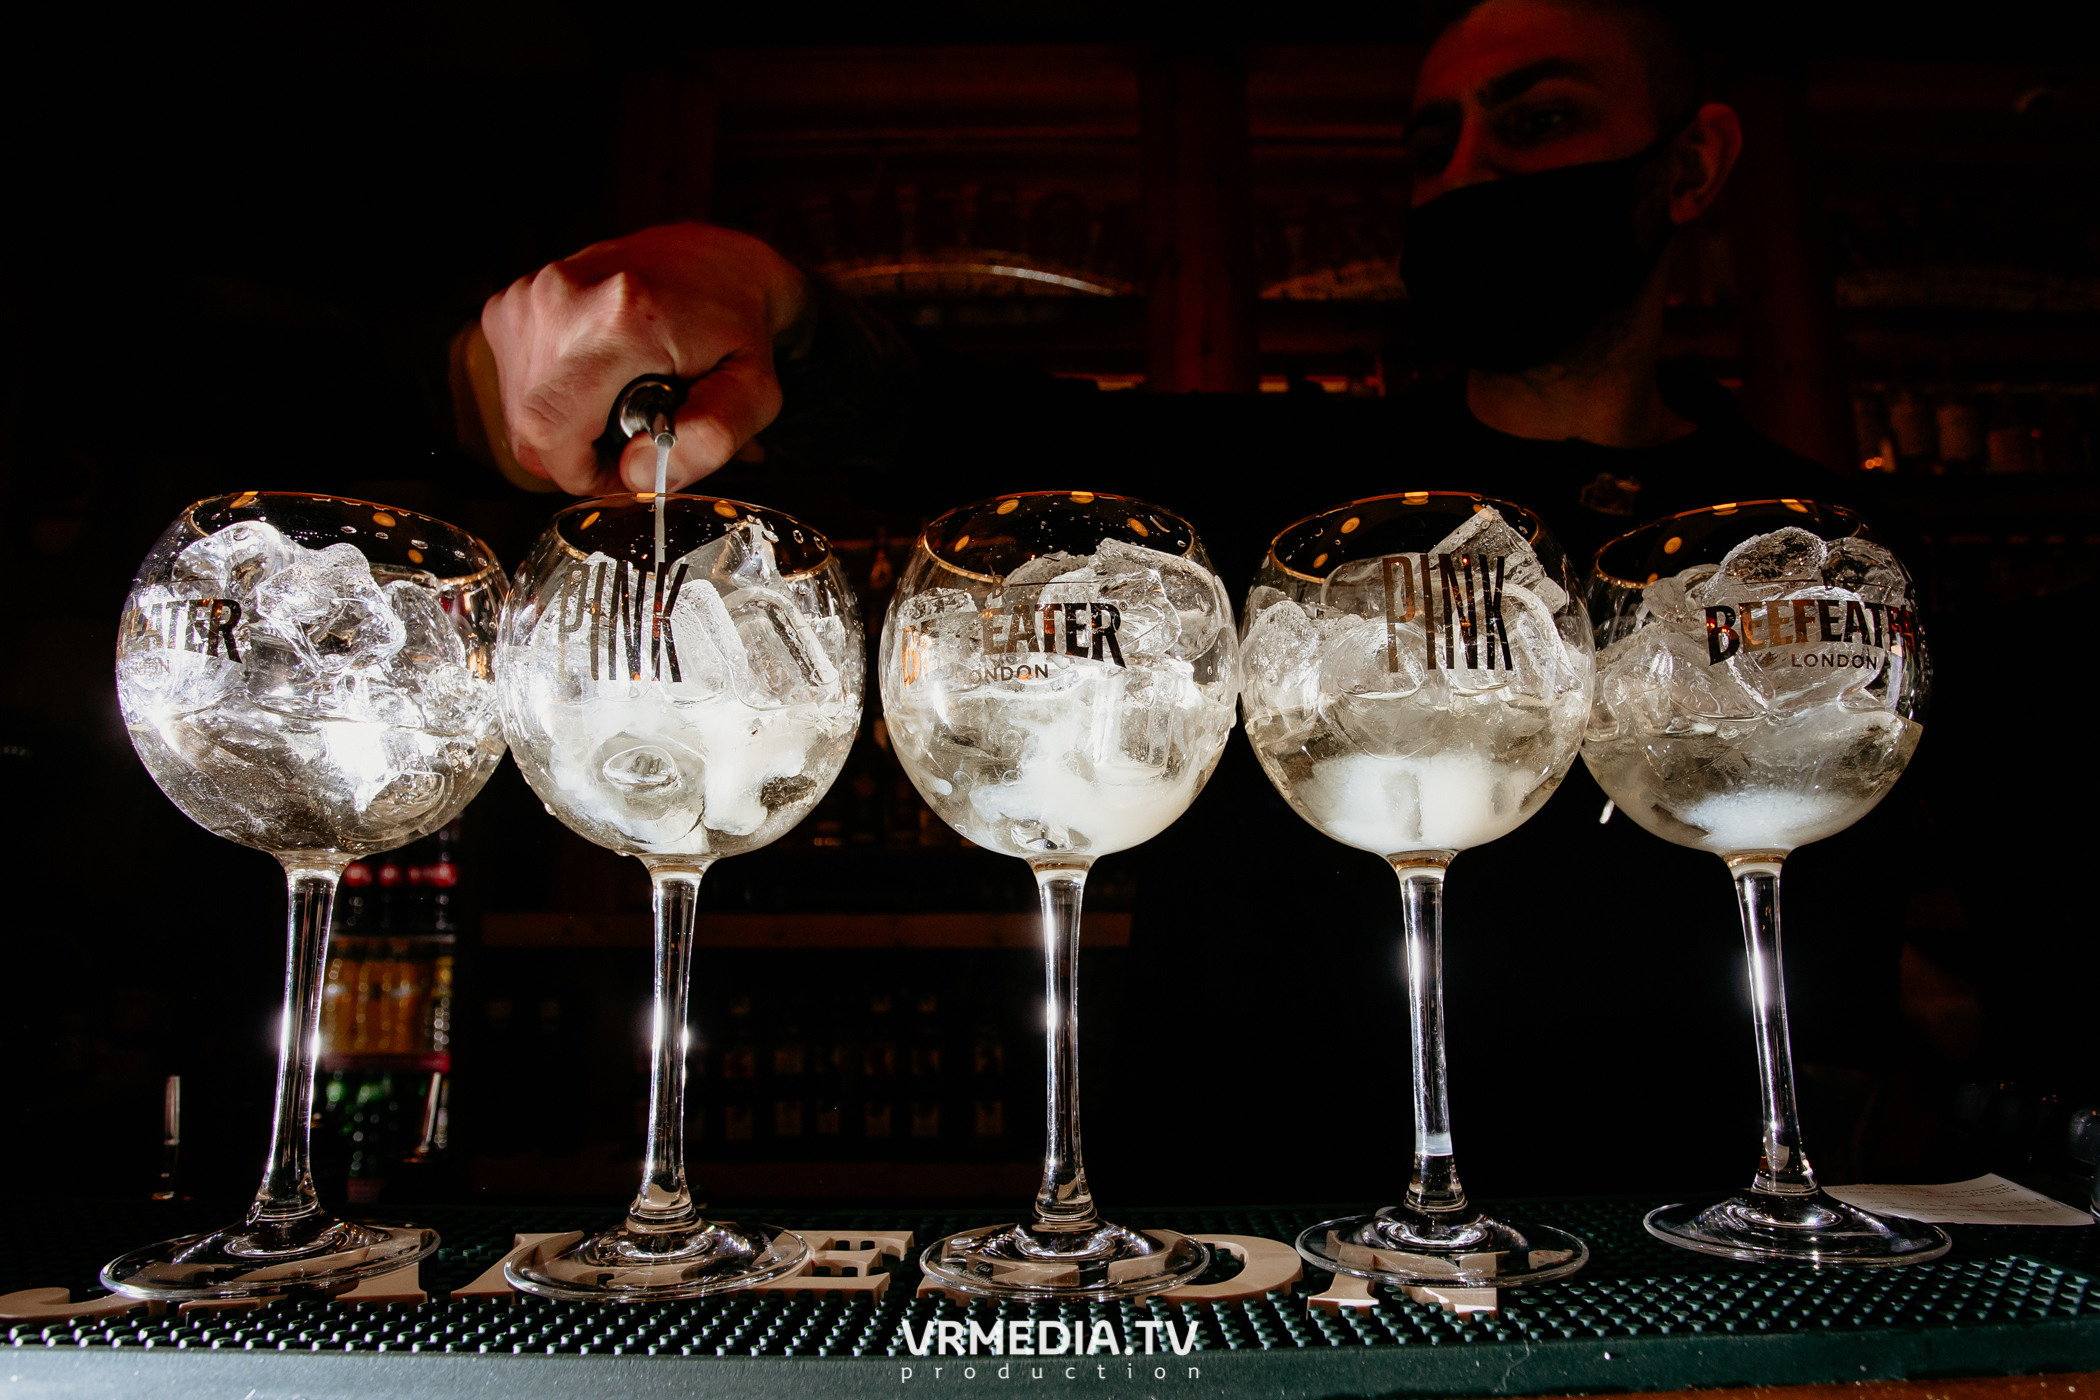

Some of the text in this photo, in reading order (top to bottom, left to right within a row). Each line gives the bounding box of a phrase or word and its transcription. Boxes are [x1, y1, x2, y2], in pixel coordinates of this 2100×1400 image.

[558, 560, 689, 683] PINK
[1382, 553, 1513, 672] PINK
[1791, 653, 1877, 670] LONDON
